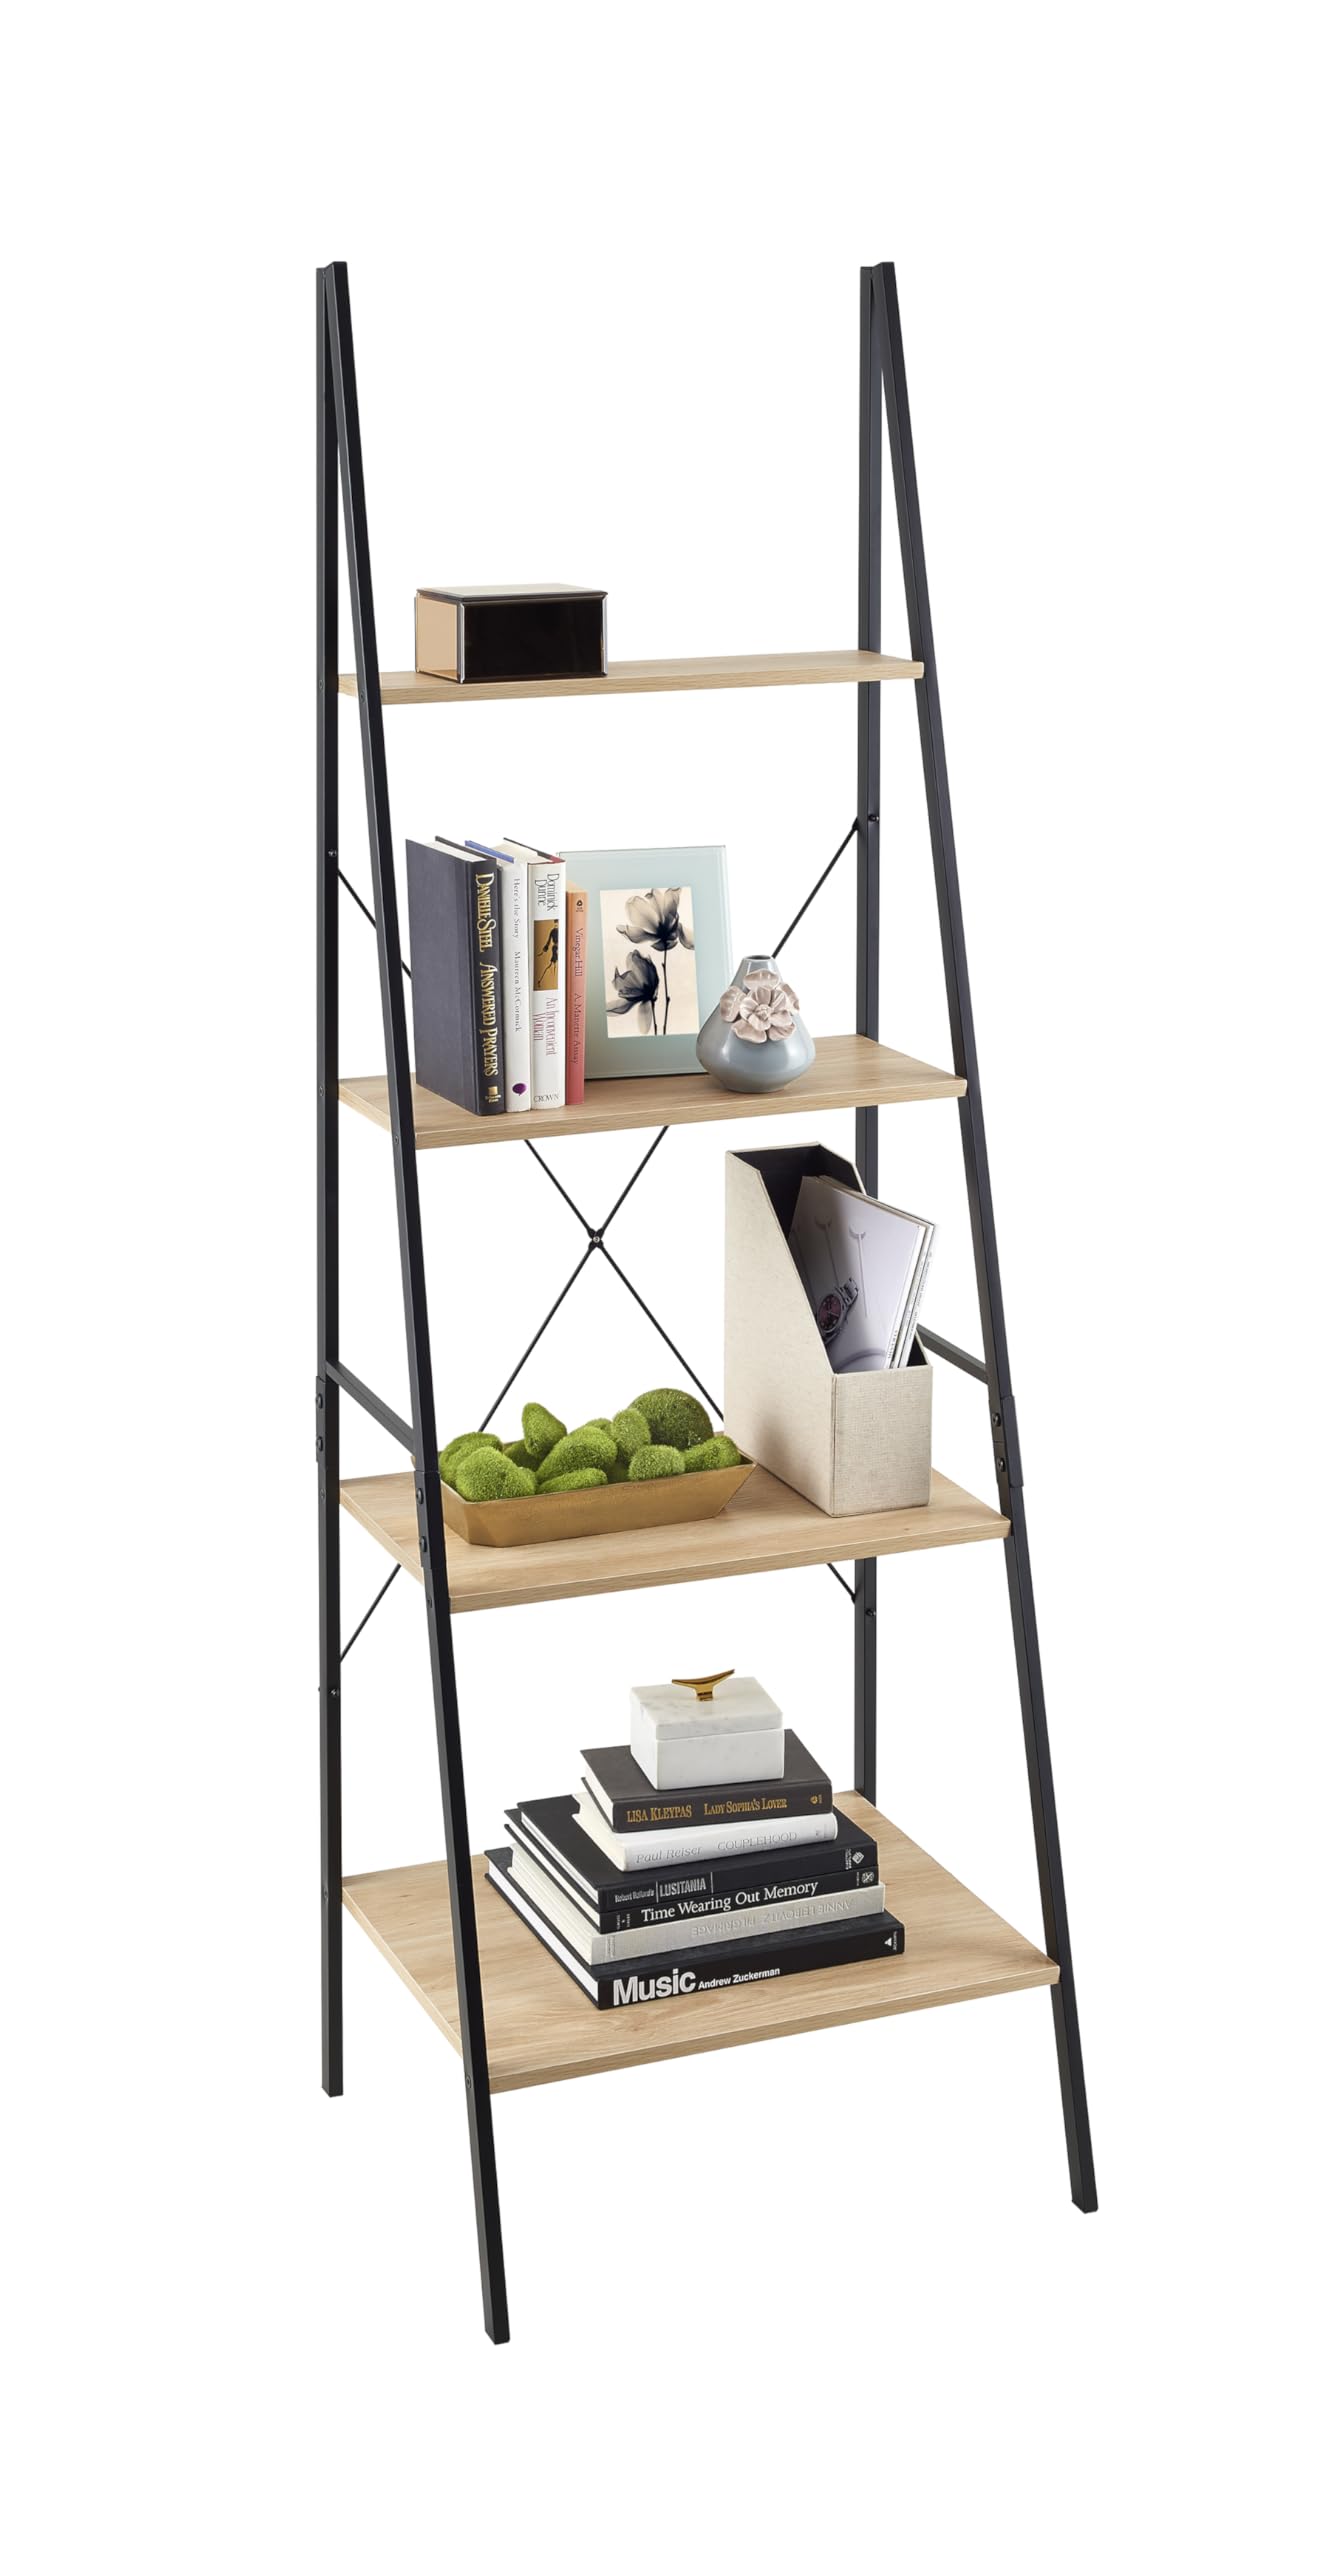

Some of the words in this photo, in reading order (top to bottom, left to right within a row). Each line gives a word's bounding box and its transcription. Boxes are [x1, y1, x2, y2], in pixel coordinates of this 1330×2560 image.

[475, 872, 495, 920] DANIELLE
[535, 879, 548, 906] Dunne
[547, 873, 560, 911] Dominick
[513, 903, 521, 916] the
[477, 919, 497, 952] STEEL
[513, 917, 521, 939] Story
[573, 928, 584, 961] Vinegar
[574, 960, 583, 977] Hill
[480, 962, 498, 1026] ANSWERED
[547, 997, 559, 1011] An
[479, 1027, 499, 1077] PRAYERS
[534, 1093, 560, 1103] CROWN
[627, 1808, 649, 1823] LISA
[650, 1804, 693, 1821] KLEYPAS
[704, 1803, 726, 1816] LADY
[761, 1798, 788, 1810] LOVER
[717, 1832, 797, 1850] COUPLEHOOD
[635, 1850, 662, 1864] Paul
[660, 1877, 707, 1898] LUSITANIA
[641, 1906, 676, 1922] Time
[678, 1896, 732, 1915] Wearing
[735, 1890, 761, 1906] Out
[763, 1881, 819, 1901] Memory
[612, 1967, 697, 2007] Music
[698, 1976, 732, 1991] Andrew
[733, 1967, 781, 1984] Zuckerman
